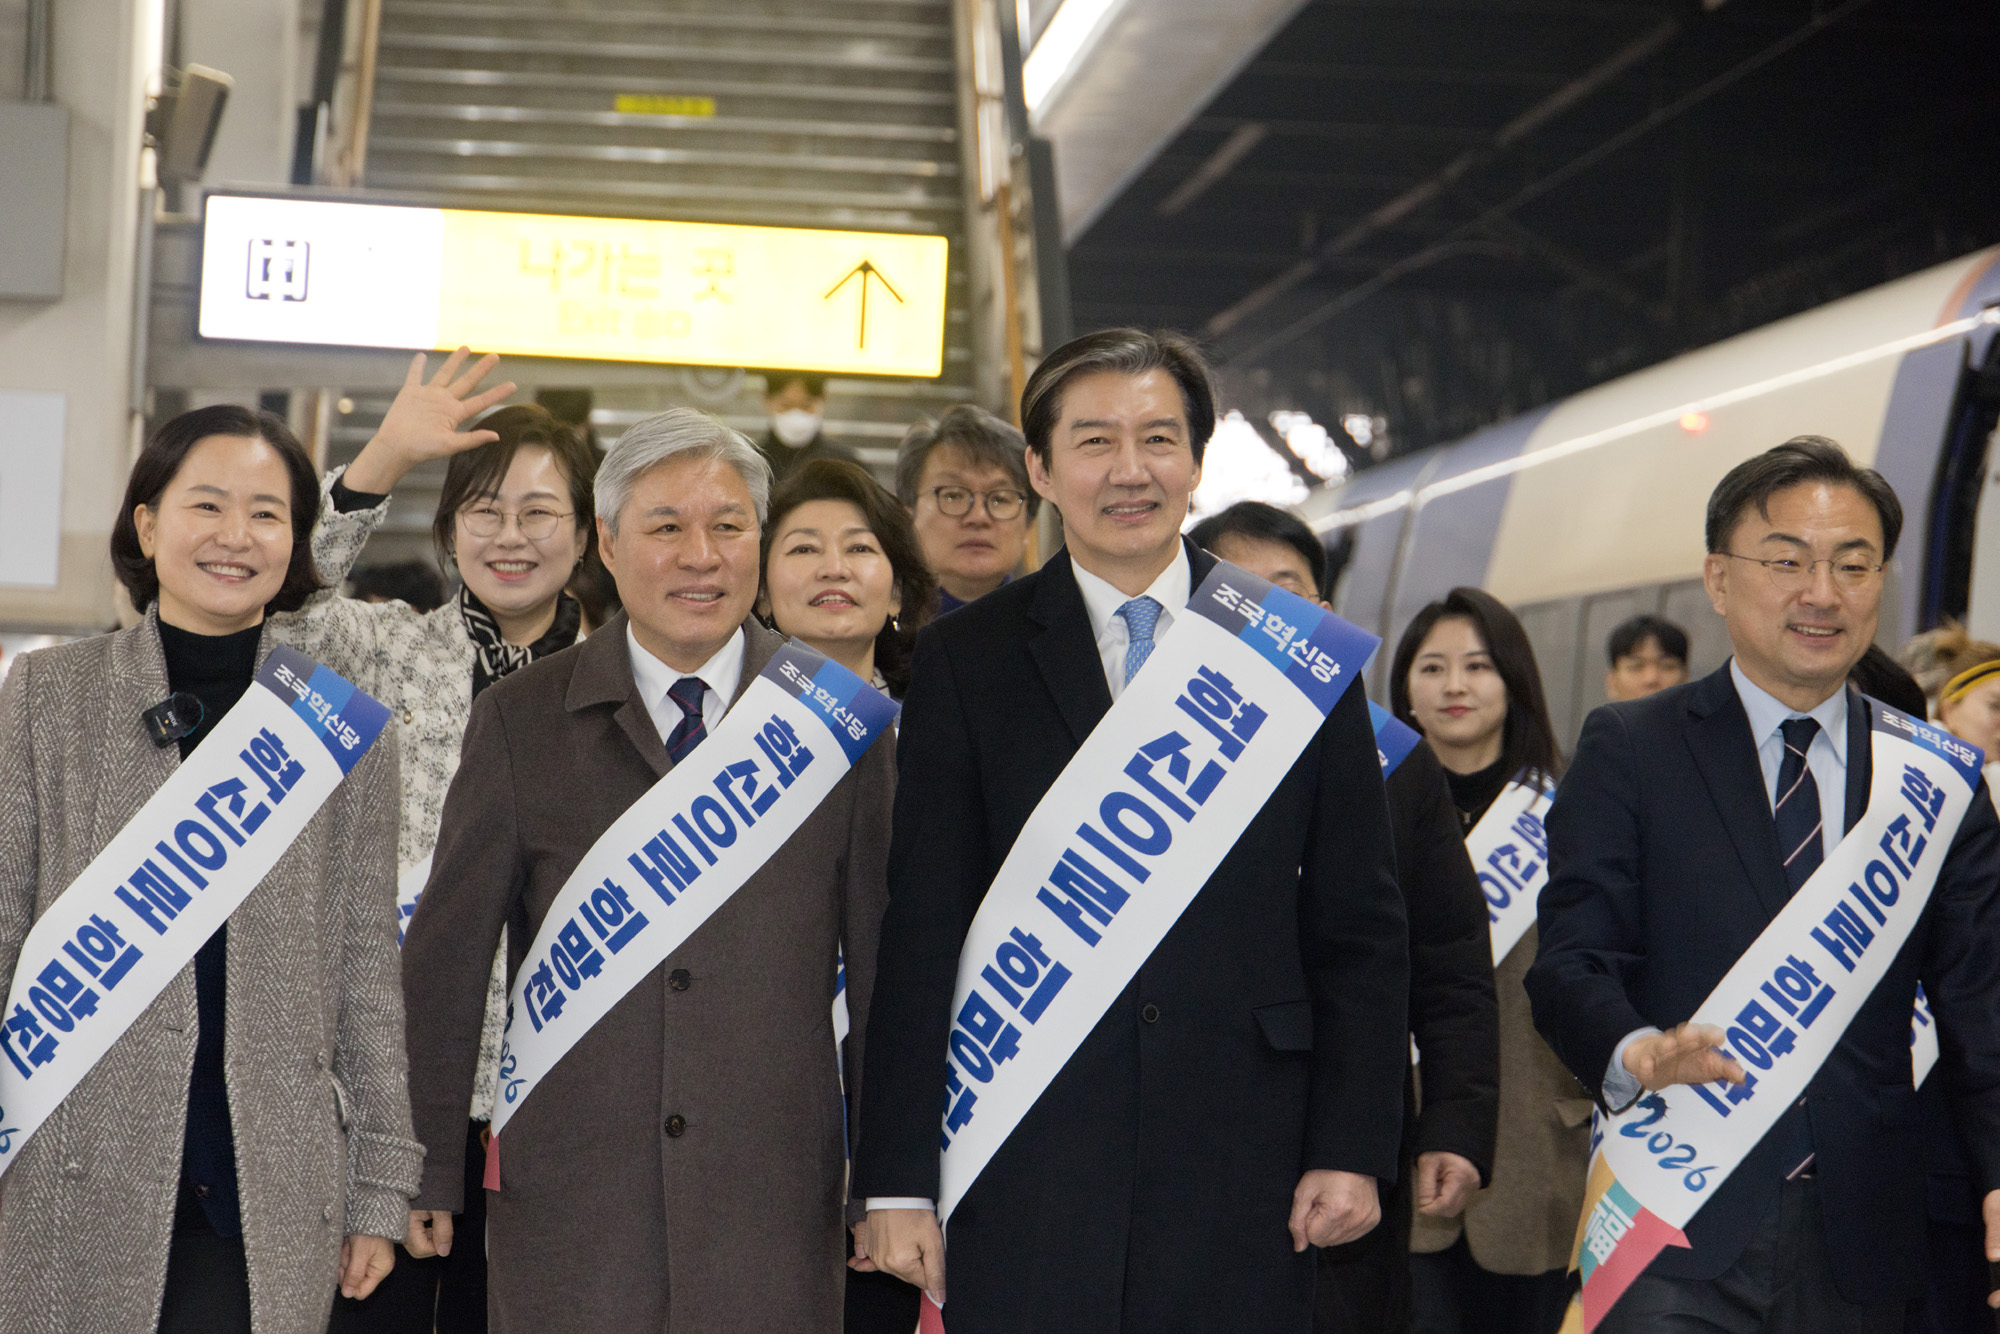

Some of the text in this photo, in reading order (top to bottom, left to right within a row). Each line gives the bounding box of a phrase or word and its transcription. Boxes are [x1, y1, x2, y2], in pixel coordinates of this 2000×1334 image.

[519, 236, 735, 303] 나가는 곳
[558, 299, 621, 335] Exit
[1212, 582, 1341, 683] 조국혁신당
[273, 664, 360, 750] 조국혁신당
[779, 660, 867, 741] 조국혁신당
[1882, 710, 1977, 767] 조국혁신당
[1036, 664, 1268, 948] 혁신으로
[0, 727, 305, 1079] 혁신으로 희망찬
[524, 713, 815, 1034] 혁신으로 희망찬
[1810, 763, 1947, 973] 혁신으로
[1619, 1092, 1720, 1193] 2026
